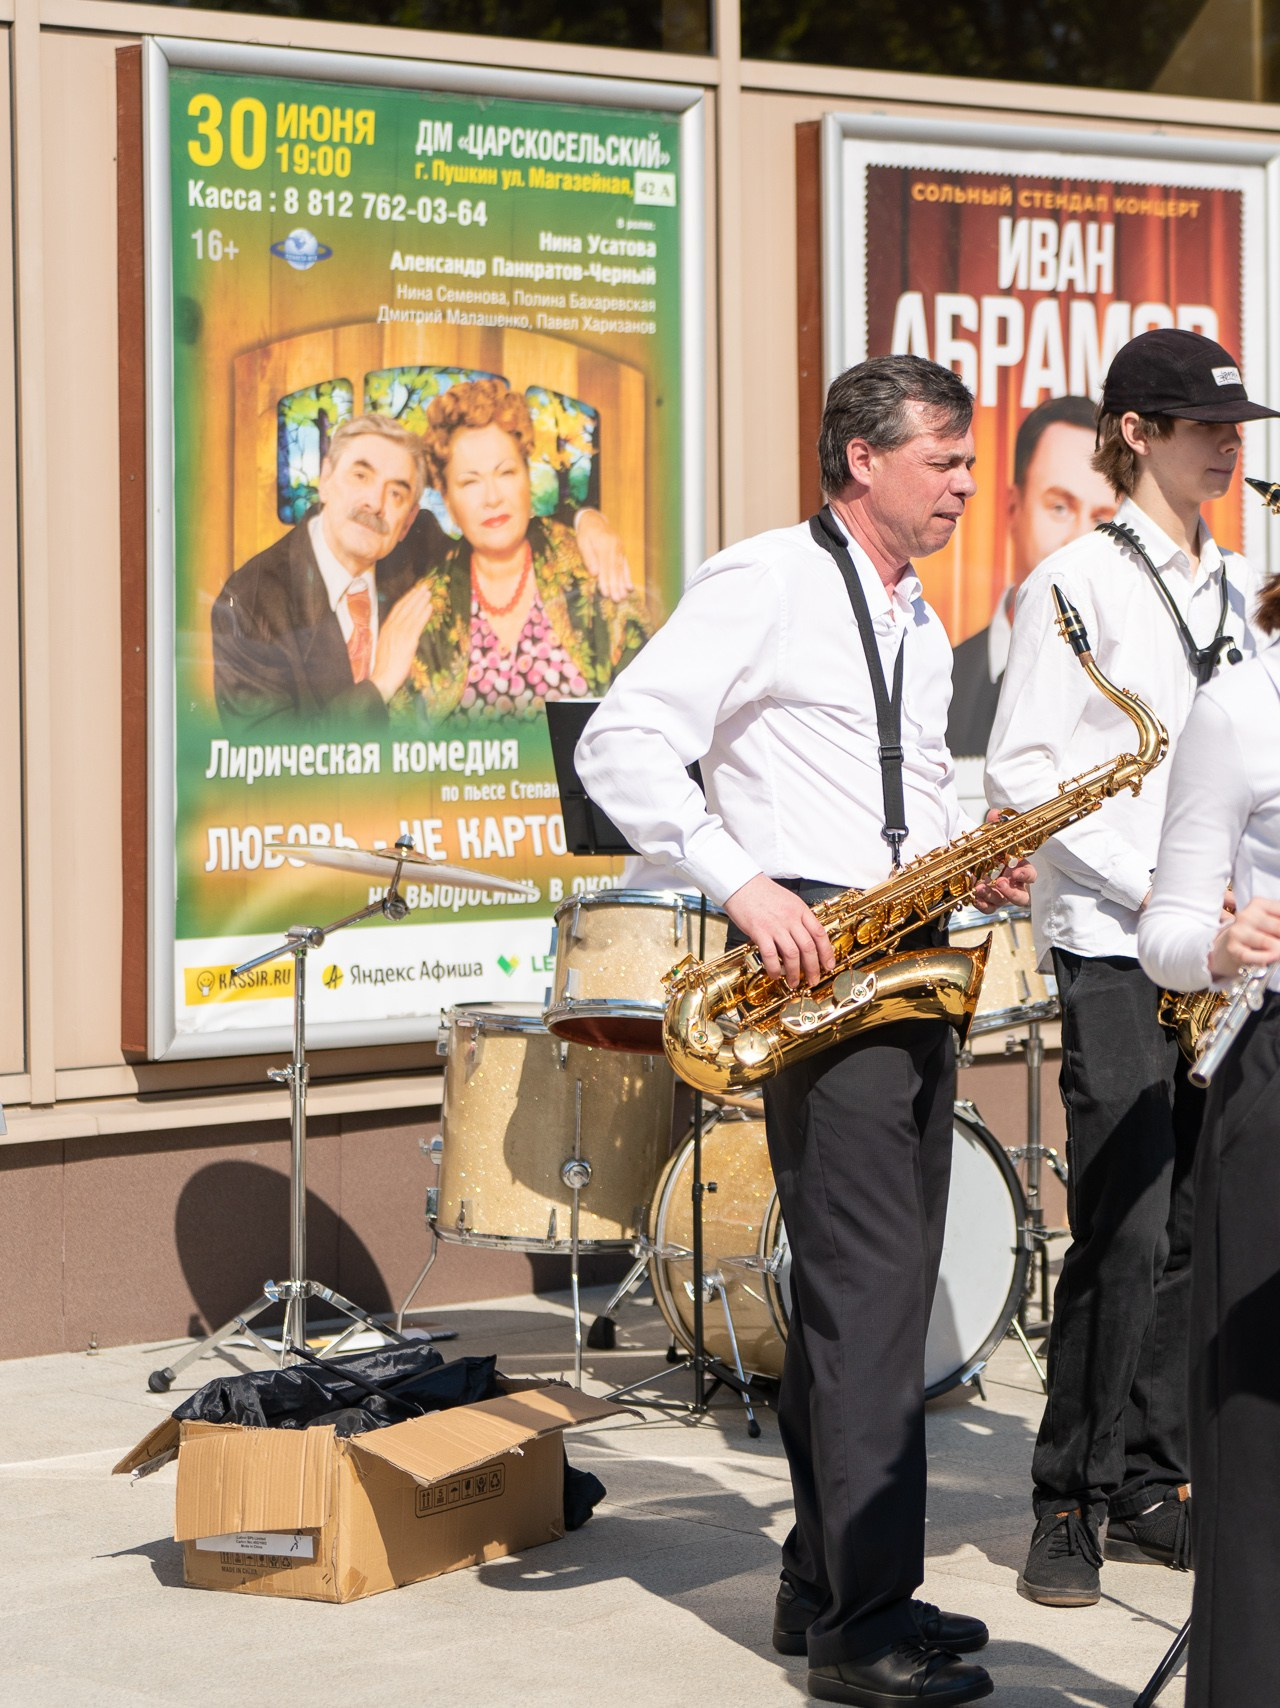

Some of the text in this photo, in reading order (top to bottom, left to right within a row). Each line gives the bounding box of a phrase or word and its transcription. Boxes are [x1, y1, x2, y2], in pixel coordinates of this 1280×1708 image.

[187, 93, 376, 170] 30 ИЮНЯ
[415, 119, 671, 169] ДМ «ЦАРСКОСЕЛЬСКИЙ»
[275, 142, 351, 178] 19:00
[415, 159, 635, 198] г. Пушкин ул. Магазейная,
[639, 180, 656, 197] 42
[188, 178, 262, 212] Касса
[283, 186, 299, 215] 8
[307, 188, 354, 218] 812
[361, 191, 488, 227] 762-03-64
[911, 182, 1200, 219] СОЛЬНЫЙ СТЕНДАП КОНЦЕРТ
[190, 228, 239, 262] 16+
[538, 231, 657, 258] Нина Усатова
[997, 215, 1115, 295] ИВАН
[390, 250, 657, 287] Александр Панкратов-Черный
[396, 284, 657, 314] Нина Семенова, Полина Бахаревская
[377, 305, 657, 335] Дмитрий Малашенко, Павел Харизанов
[205, 738, 519, 785] Лирическая комедия
[441, 786, 459, 802] по
[464, 783, 506, 801] пьесе
[549, 877, 563, 902] в
[218, 968, 292, 990] KASSIR.RU
[350, 959, 483, 986] Яндекс Афиша
